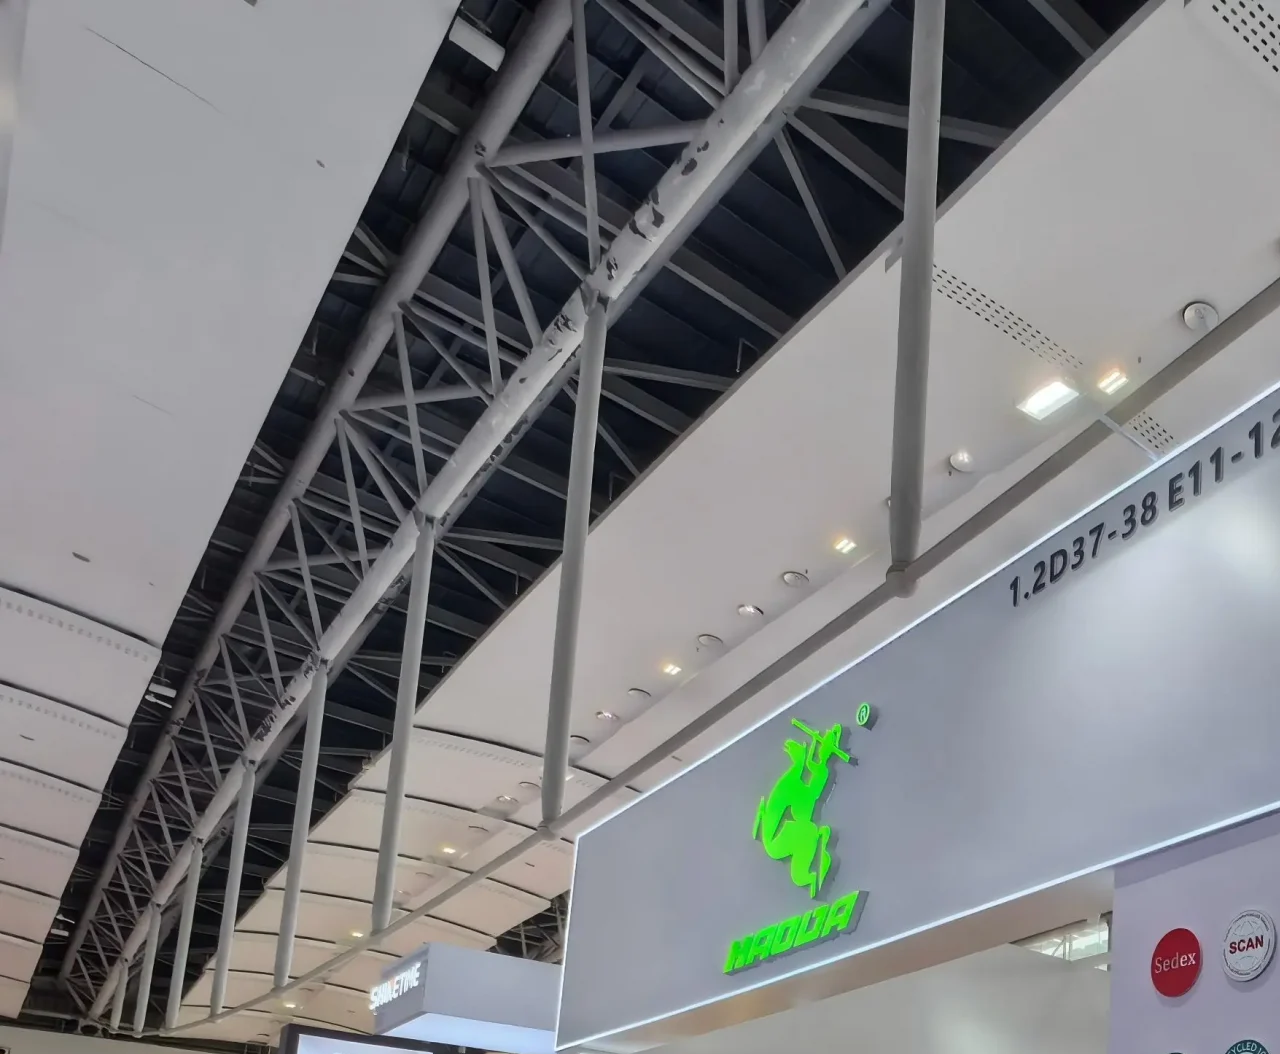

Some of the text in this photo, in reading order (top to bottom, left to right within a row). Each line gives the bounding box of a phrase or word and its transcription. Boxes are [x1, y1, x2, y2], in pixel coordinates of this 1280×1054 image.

[1009, 491, 1158, 607] 1.2D37-38
[1229, 935, 1265, 954] SCAN
[1154, 952, 1197, 974] Sedex
[369, 961, 421, 1010] SHINETIME
